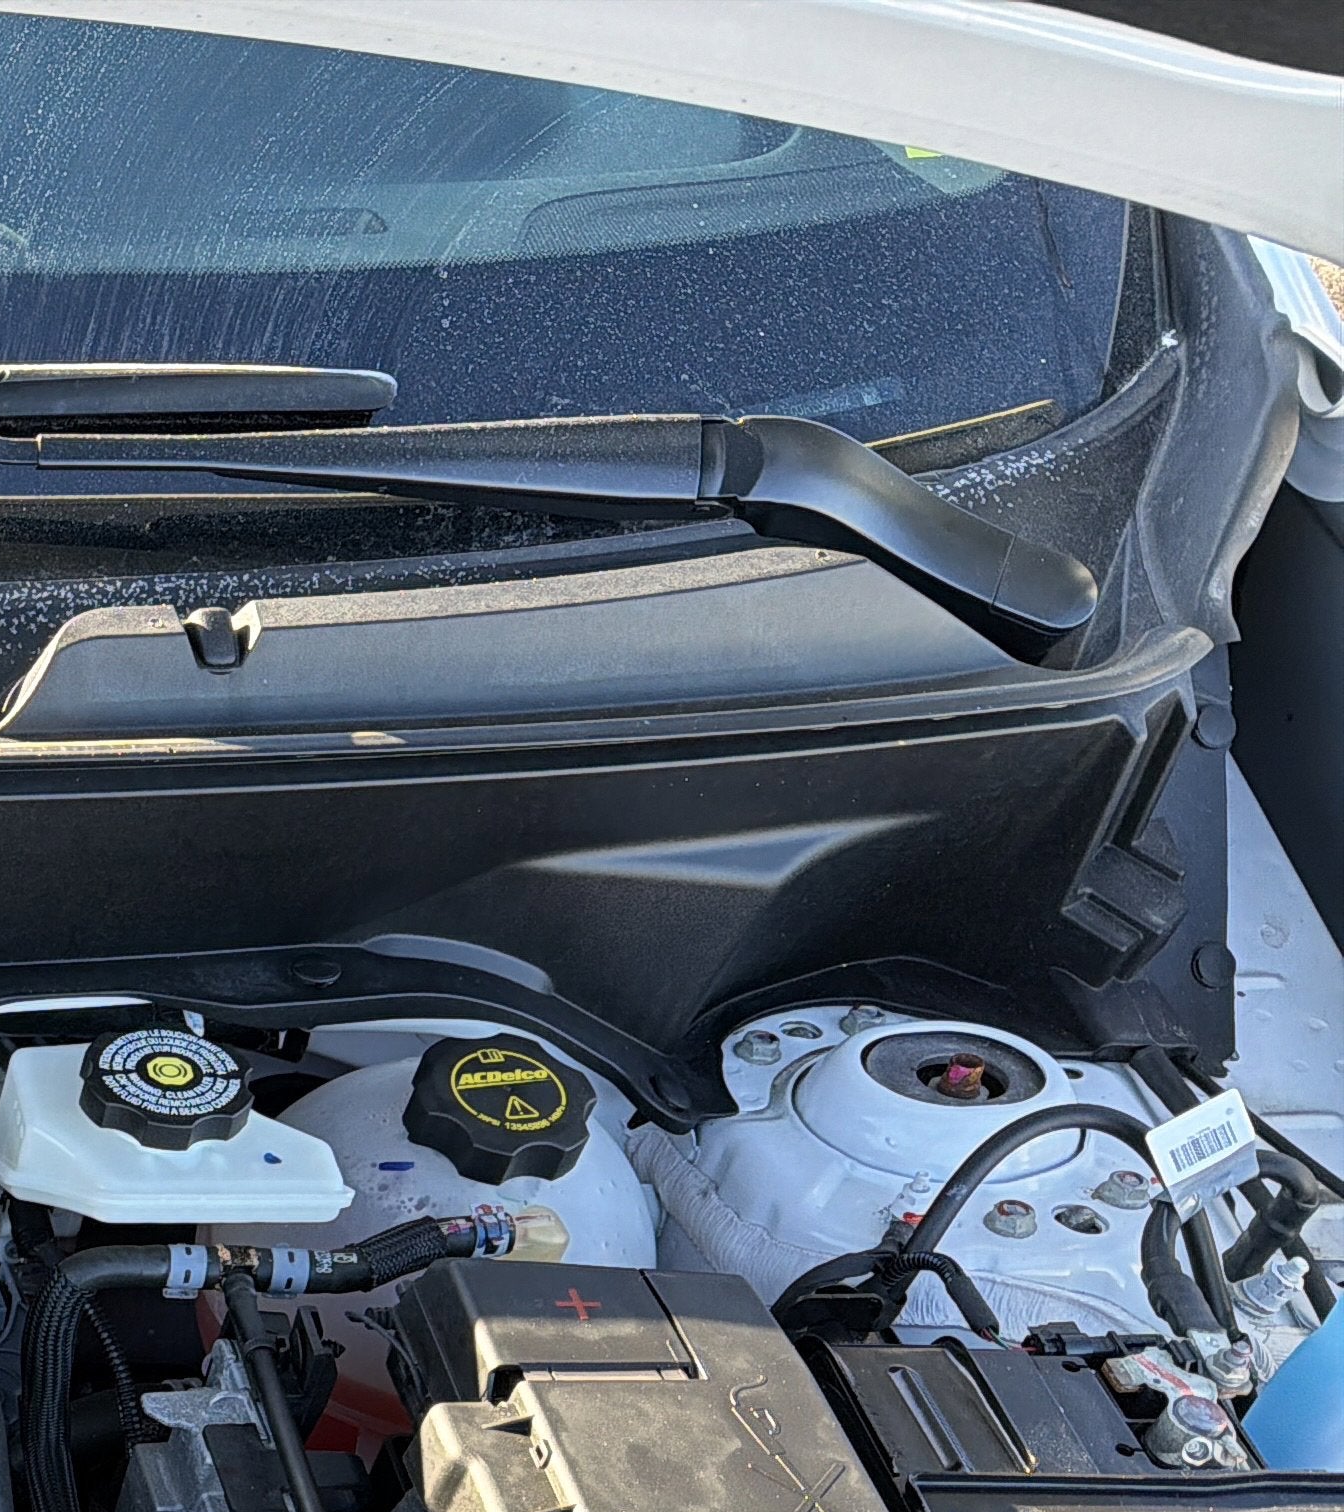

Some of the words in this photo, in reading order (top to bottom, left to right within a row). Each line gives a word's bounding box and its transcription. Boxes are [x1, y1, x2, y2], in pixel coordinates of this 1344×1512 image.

[458, 1069, 548, 1085] ACDelco
[141, 1101, 170, 1115] FROM
[170, 1107, 179, 1116] A
